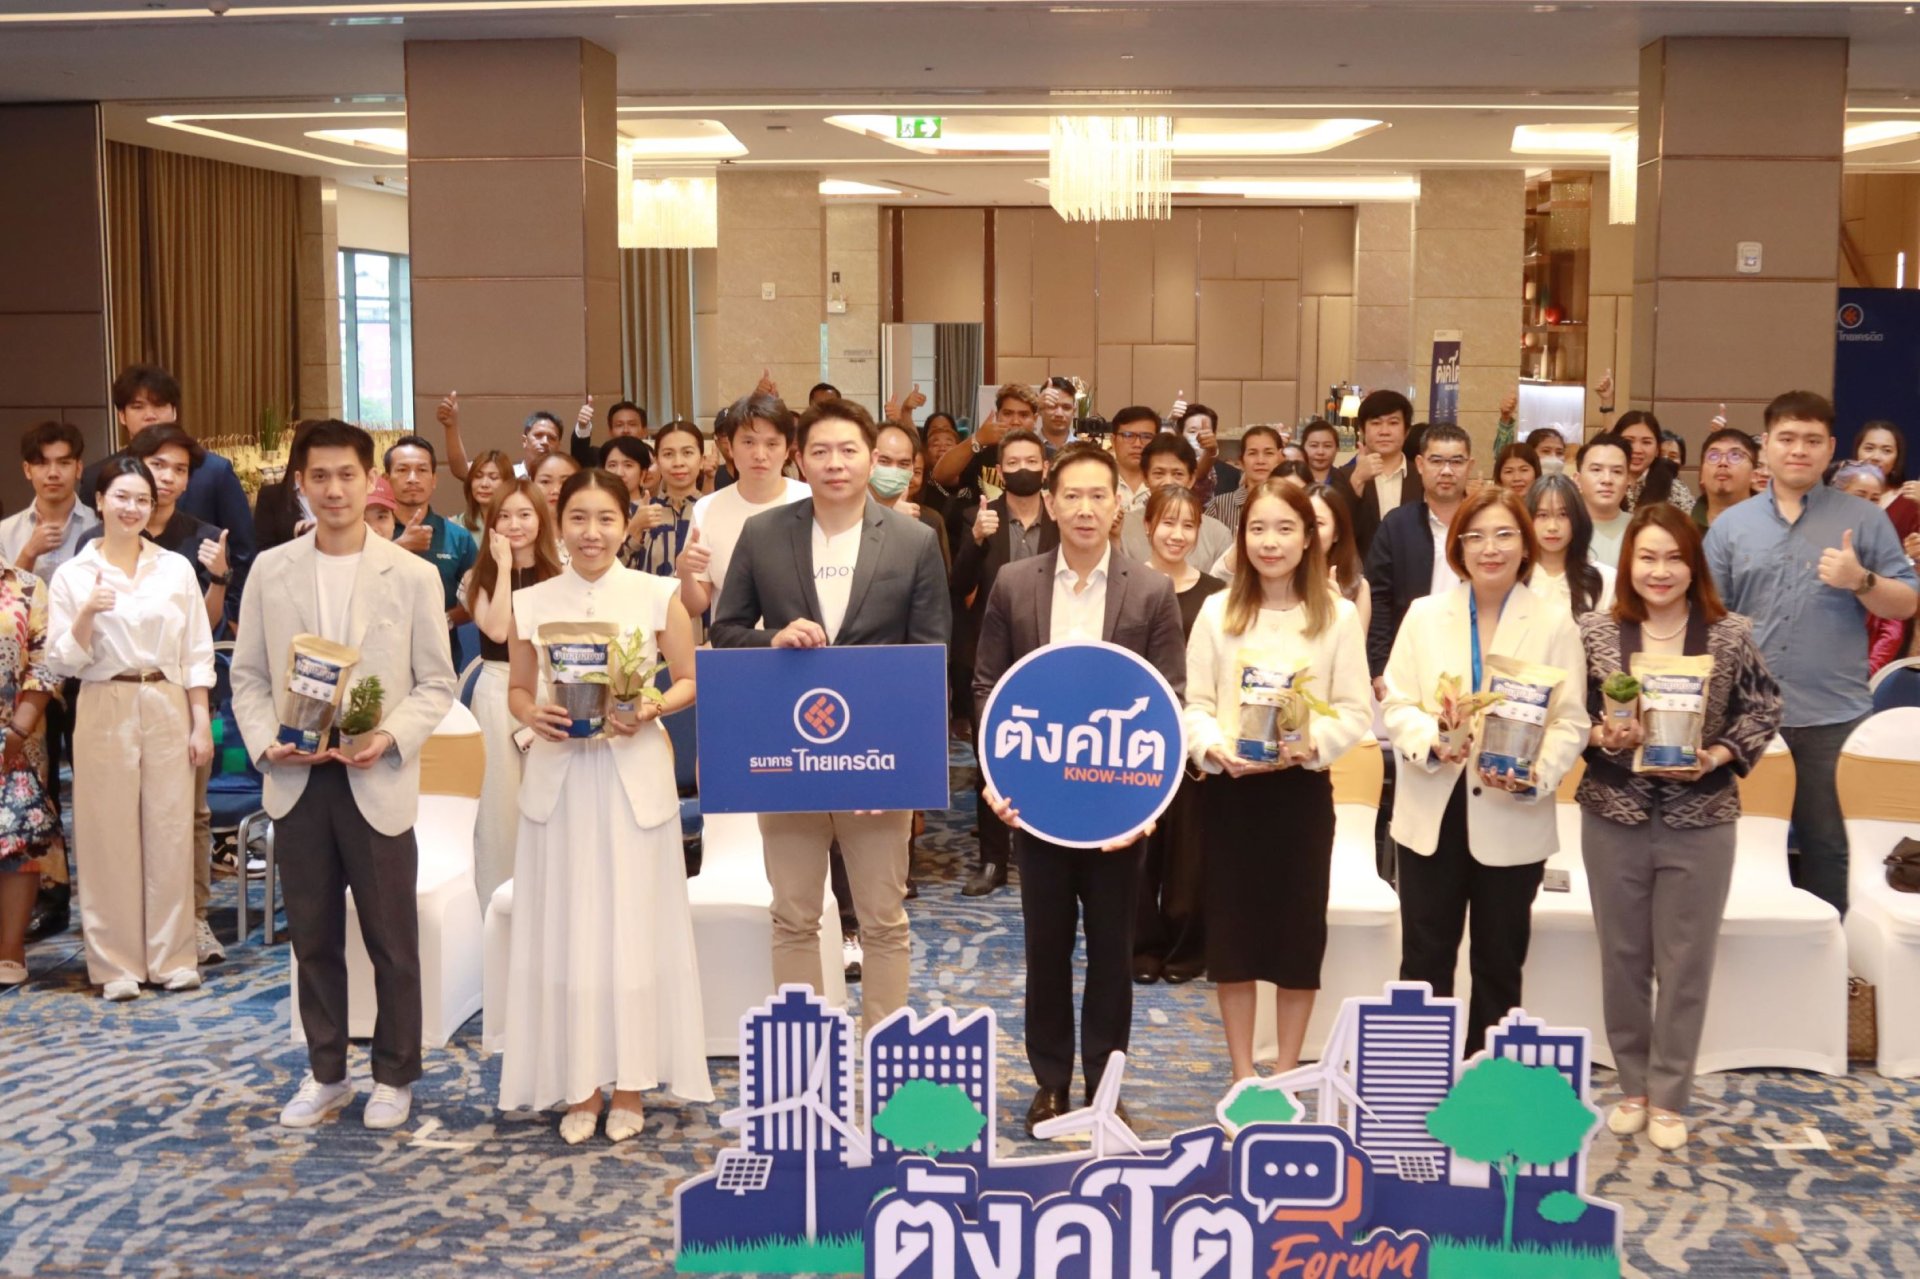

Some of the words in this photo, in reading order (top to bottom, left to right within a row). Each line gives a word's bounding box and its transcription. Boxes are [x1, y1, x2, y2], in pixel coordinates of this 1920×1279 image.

[750, 756, 793, 768] ธนาคาร
[791, 748, 895, 771] ไทยเครดิต
[1063, 766, 1163, 788] KNOW-HOW
